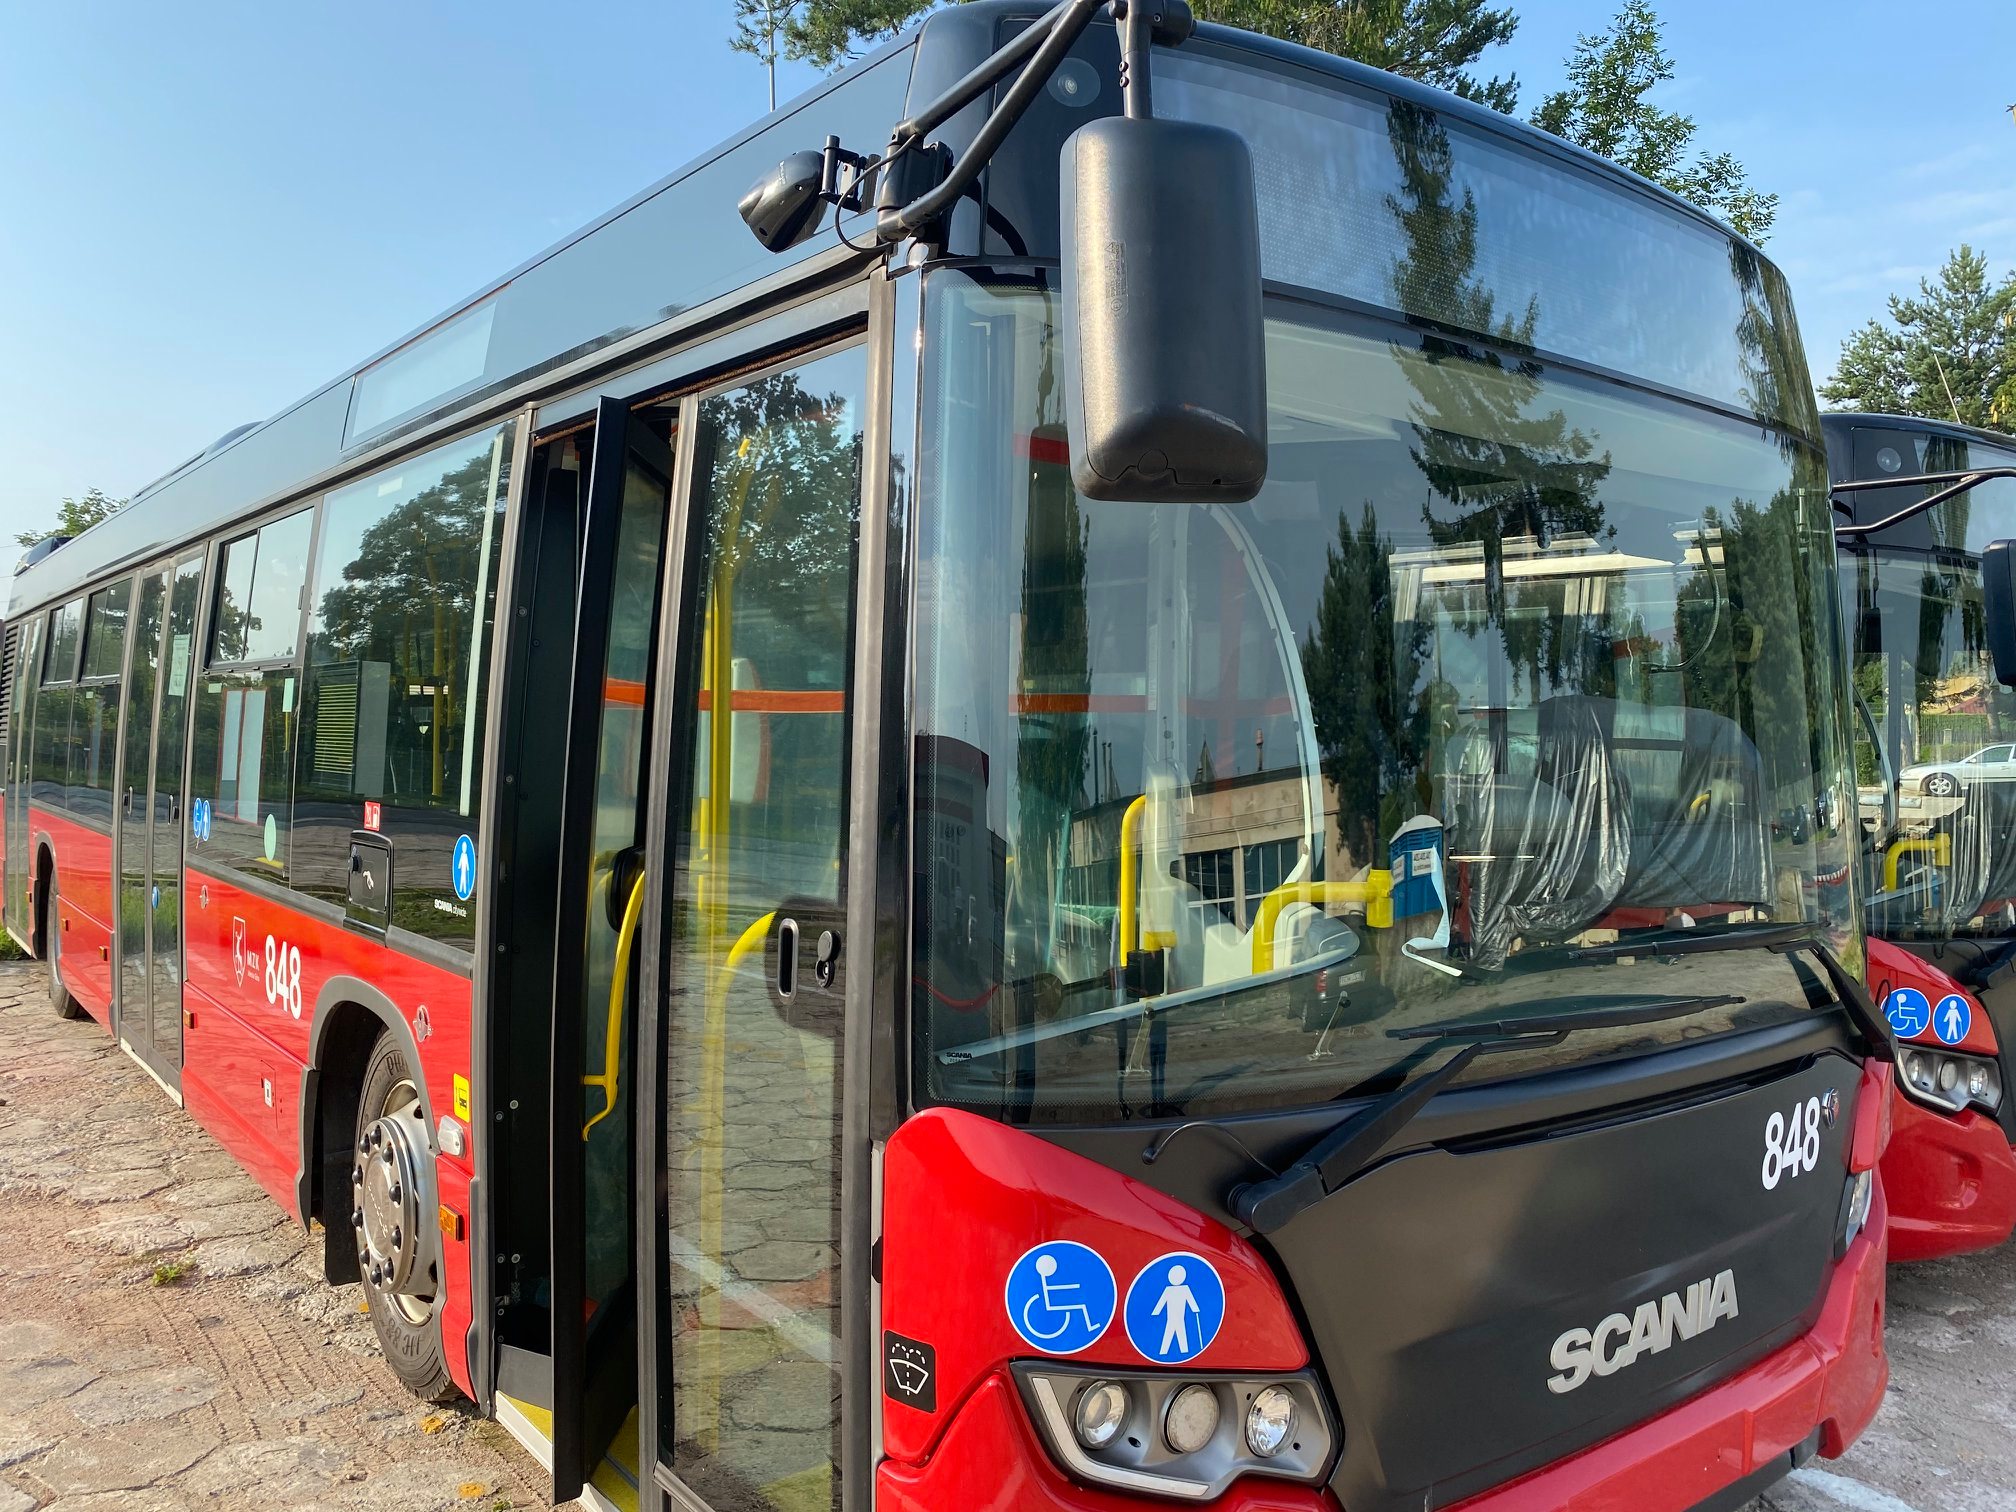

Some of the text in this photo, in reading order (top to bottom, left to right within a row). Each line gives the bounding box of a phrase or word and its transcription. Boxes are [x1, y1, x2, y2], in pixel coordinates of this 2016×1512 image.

[434, 898, 452, 913] SCANIA
[247, 949, 260, 972] MZK
[265, 934, 302, 1020] 848
[1762, 1096, 1821, 1190] 848
[1547, 1268, 1739, 1394] SCANIA
